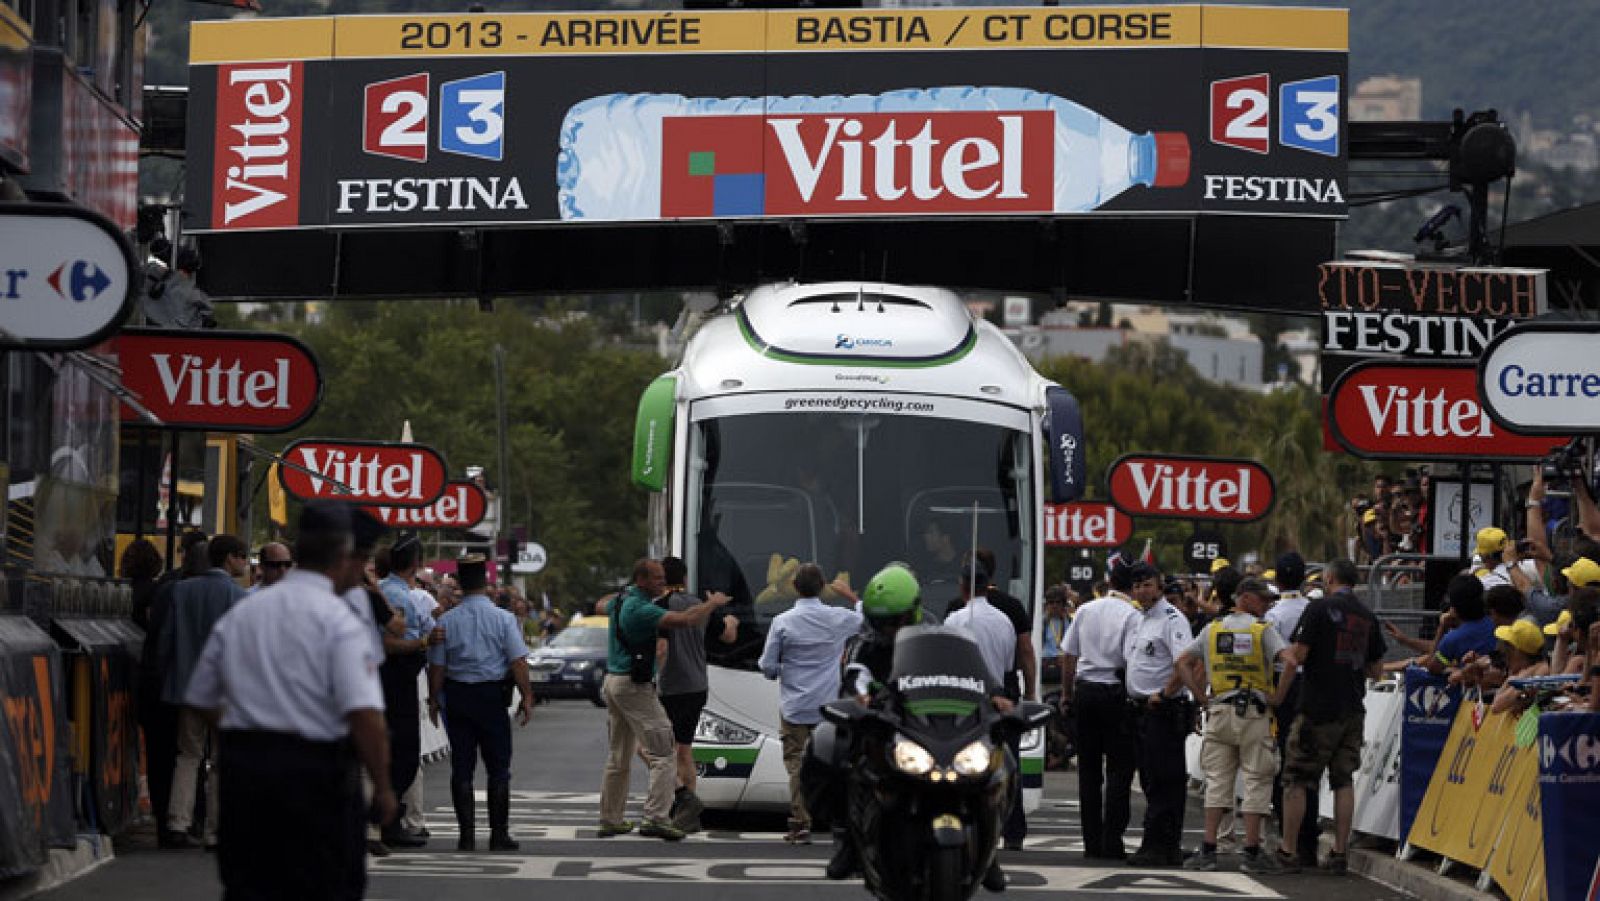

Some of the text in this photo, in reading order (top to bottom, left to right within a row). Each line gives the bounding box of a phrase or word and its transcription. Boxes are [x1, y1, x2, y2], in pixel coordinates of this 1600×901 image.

[401, 21, 502, 49] 2013
[540, 12, 701, 47] ARRIVÉE
[796, 16, 931, 44] BASTIA
[944, 15, 970, 46] /
[983, 15, 1031, 42] CT
[1045, 13, 1172, 41] CORSE
[379, 89, 505, 147] 2 3
[1225, 88, 1338, 141] 2 3
[225, 64, 292, 225] Vittel
[766, 115, 1029, 203] Vittel
[336, 176, 529, 214] FESTINA
[1203, 174, 1345, 203] FESTINA
[1324, 310, 1517, 357] FESTIN
[150, 353, 292, 410] Vittel
[1499, 364, 1600, 398] Carre
[784, 396, 935, 413] greenedgecycling.com
[299, 447, 424, 500] Vittel
[1126, 461, 1252, 515] Vittel
[1044, 505, 1119, 544] ittel
[1191, 541, 1220, 559] 25
[1071, 566, 1093, 580] 50
[897, 674, 985, 694] Kawasaki
